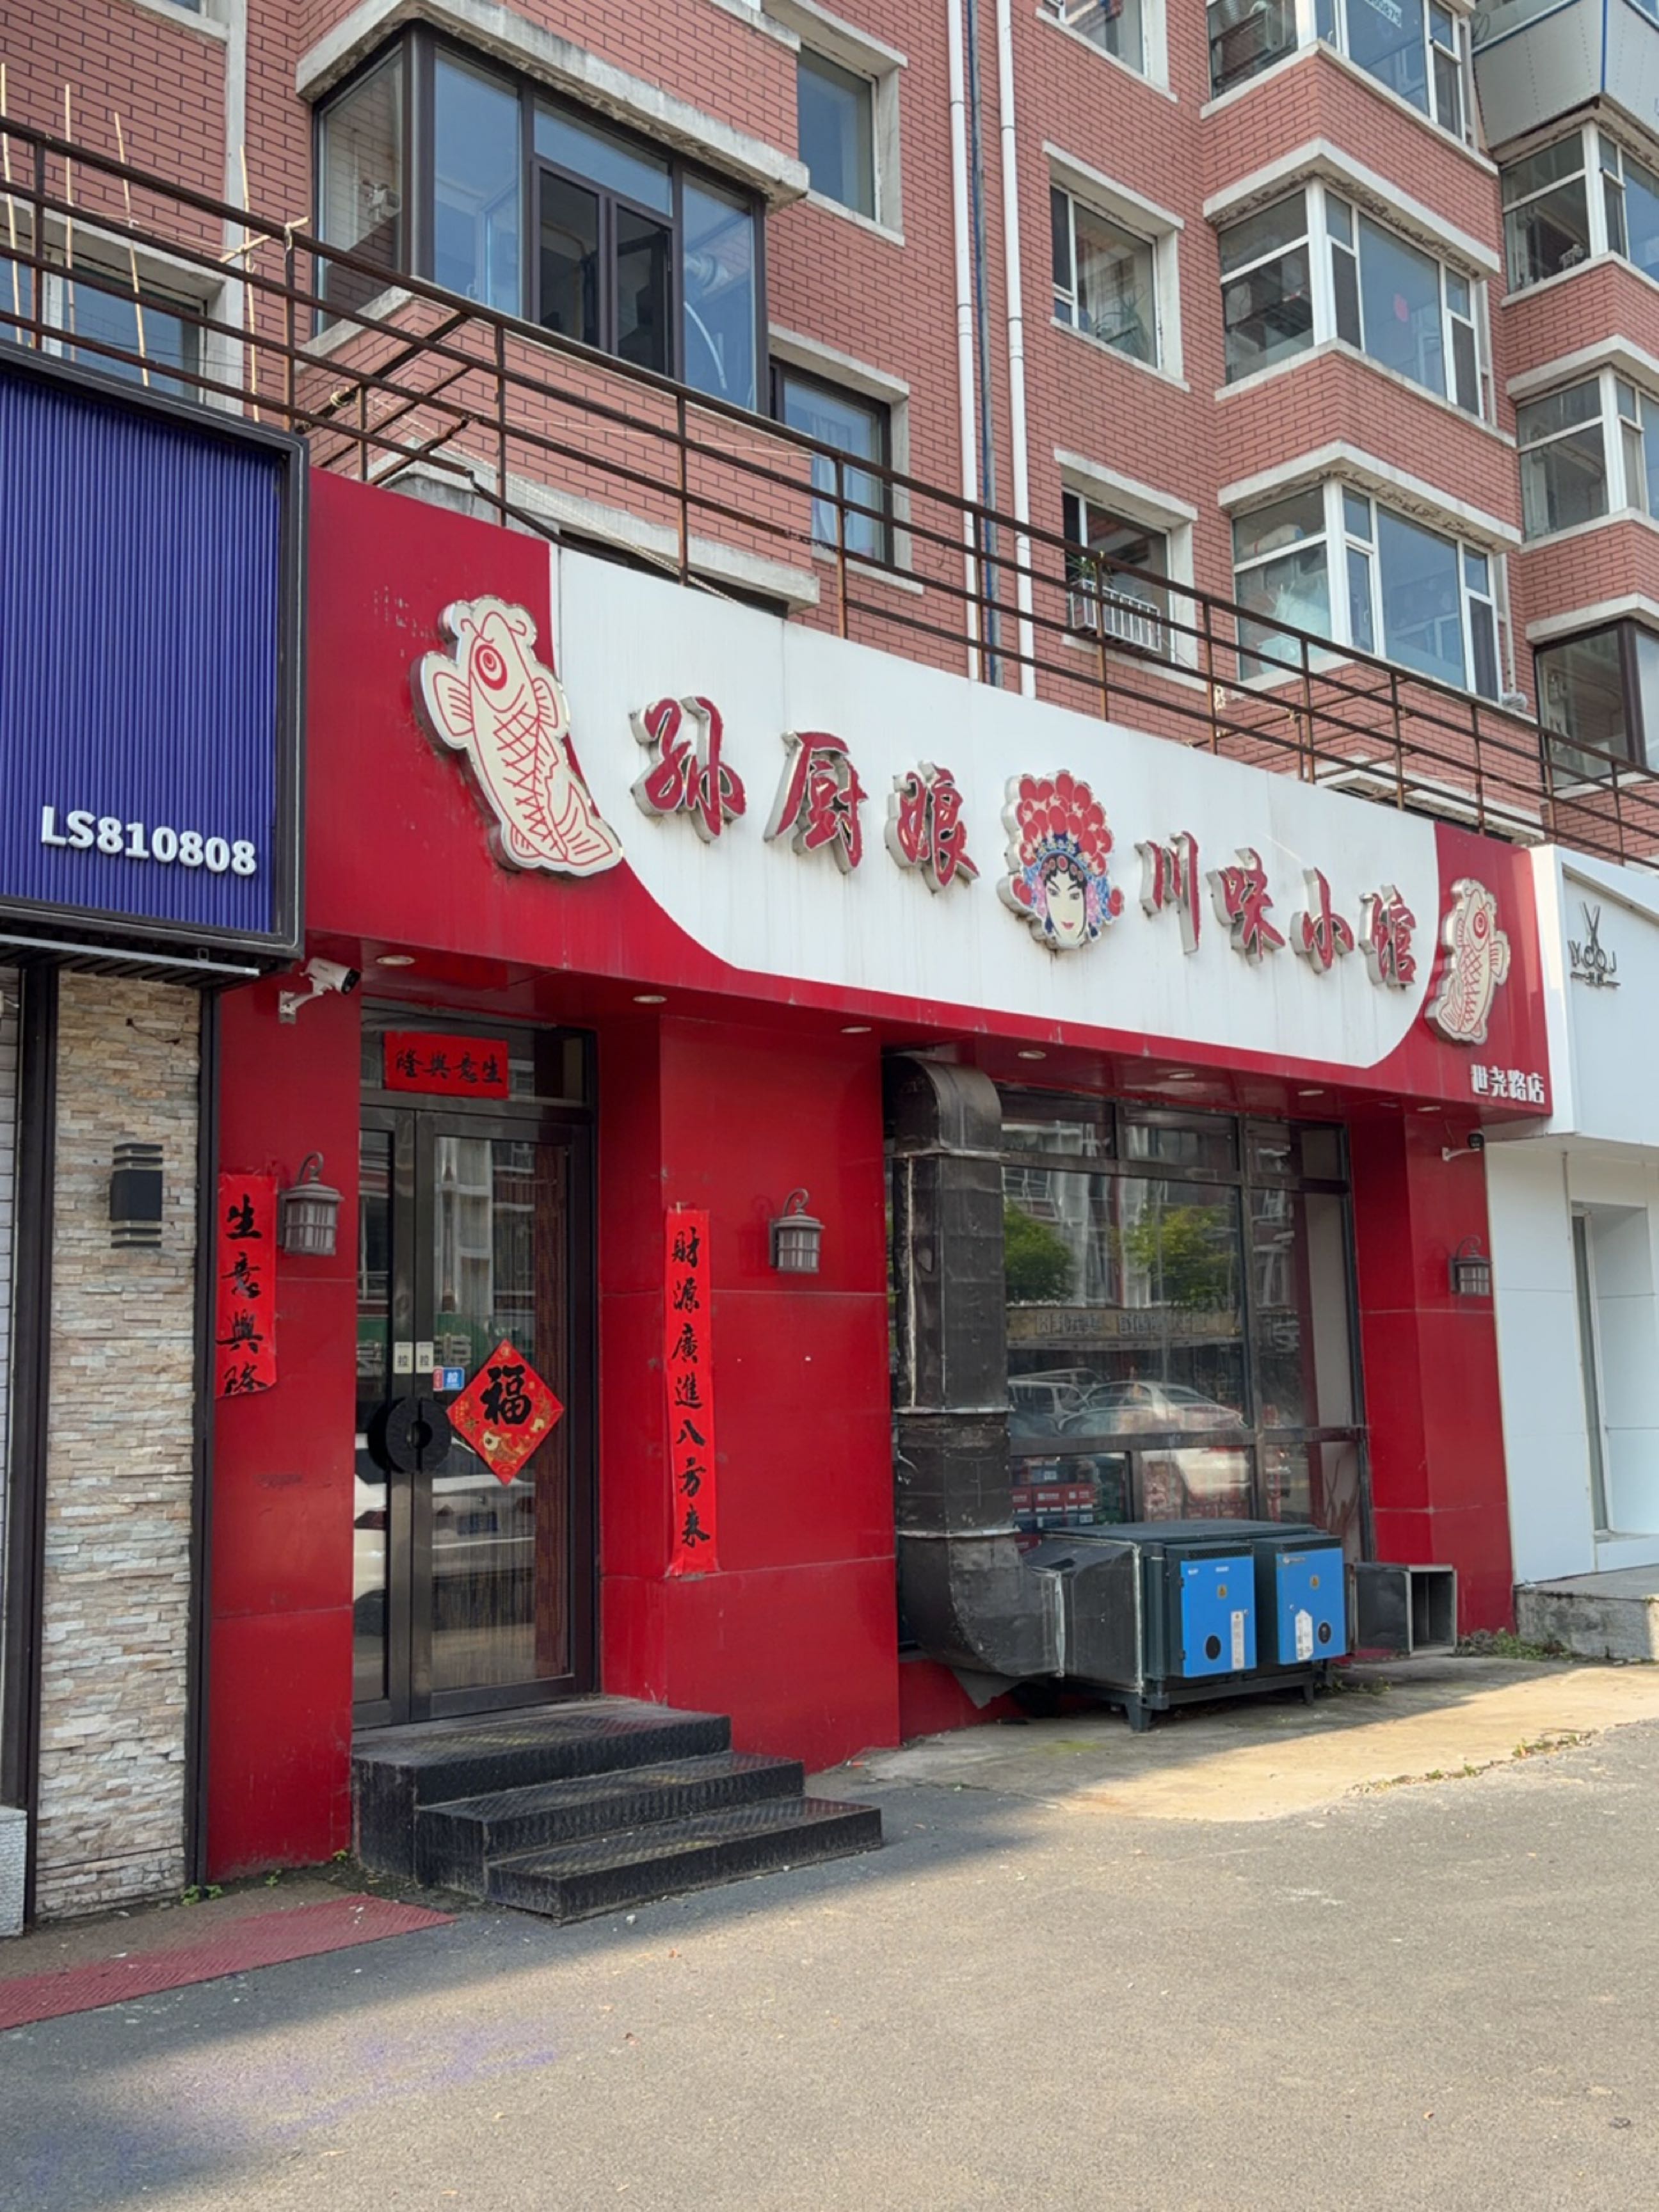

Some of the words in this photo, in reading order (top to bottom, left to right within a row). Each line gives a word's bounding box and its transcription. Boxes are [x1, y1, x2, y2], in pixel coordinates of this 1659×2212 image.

[41, 805, 257, 876] LS810808
[629, 696, 979, 894] 孙厨娘
[1135, 831, 1417, 990] 川味小馆
[479, 1365, 532, 1425] 福
